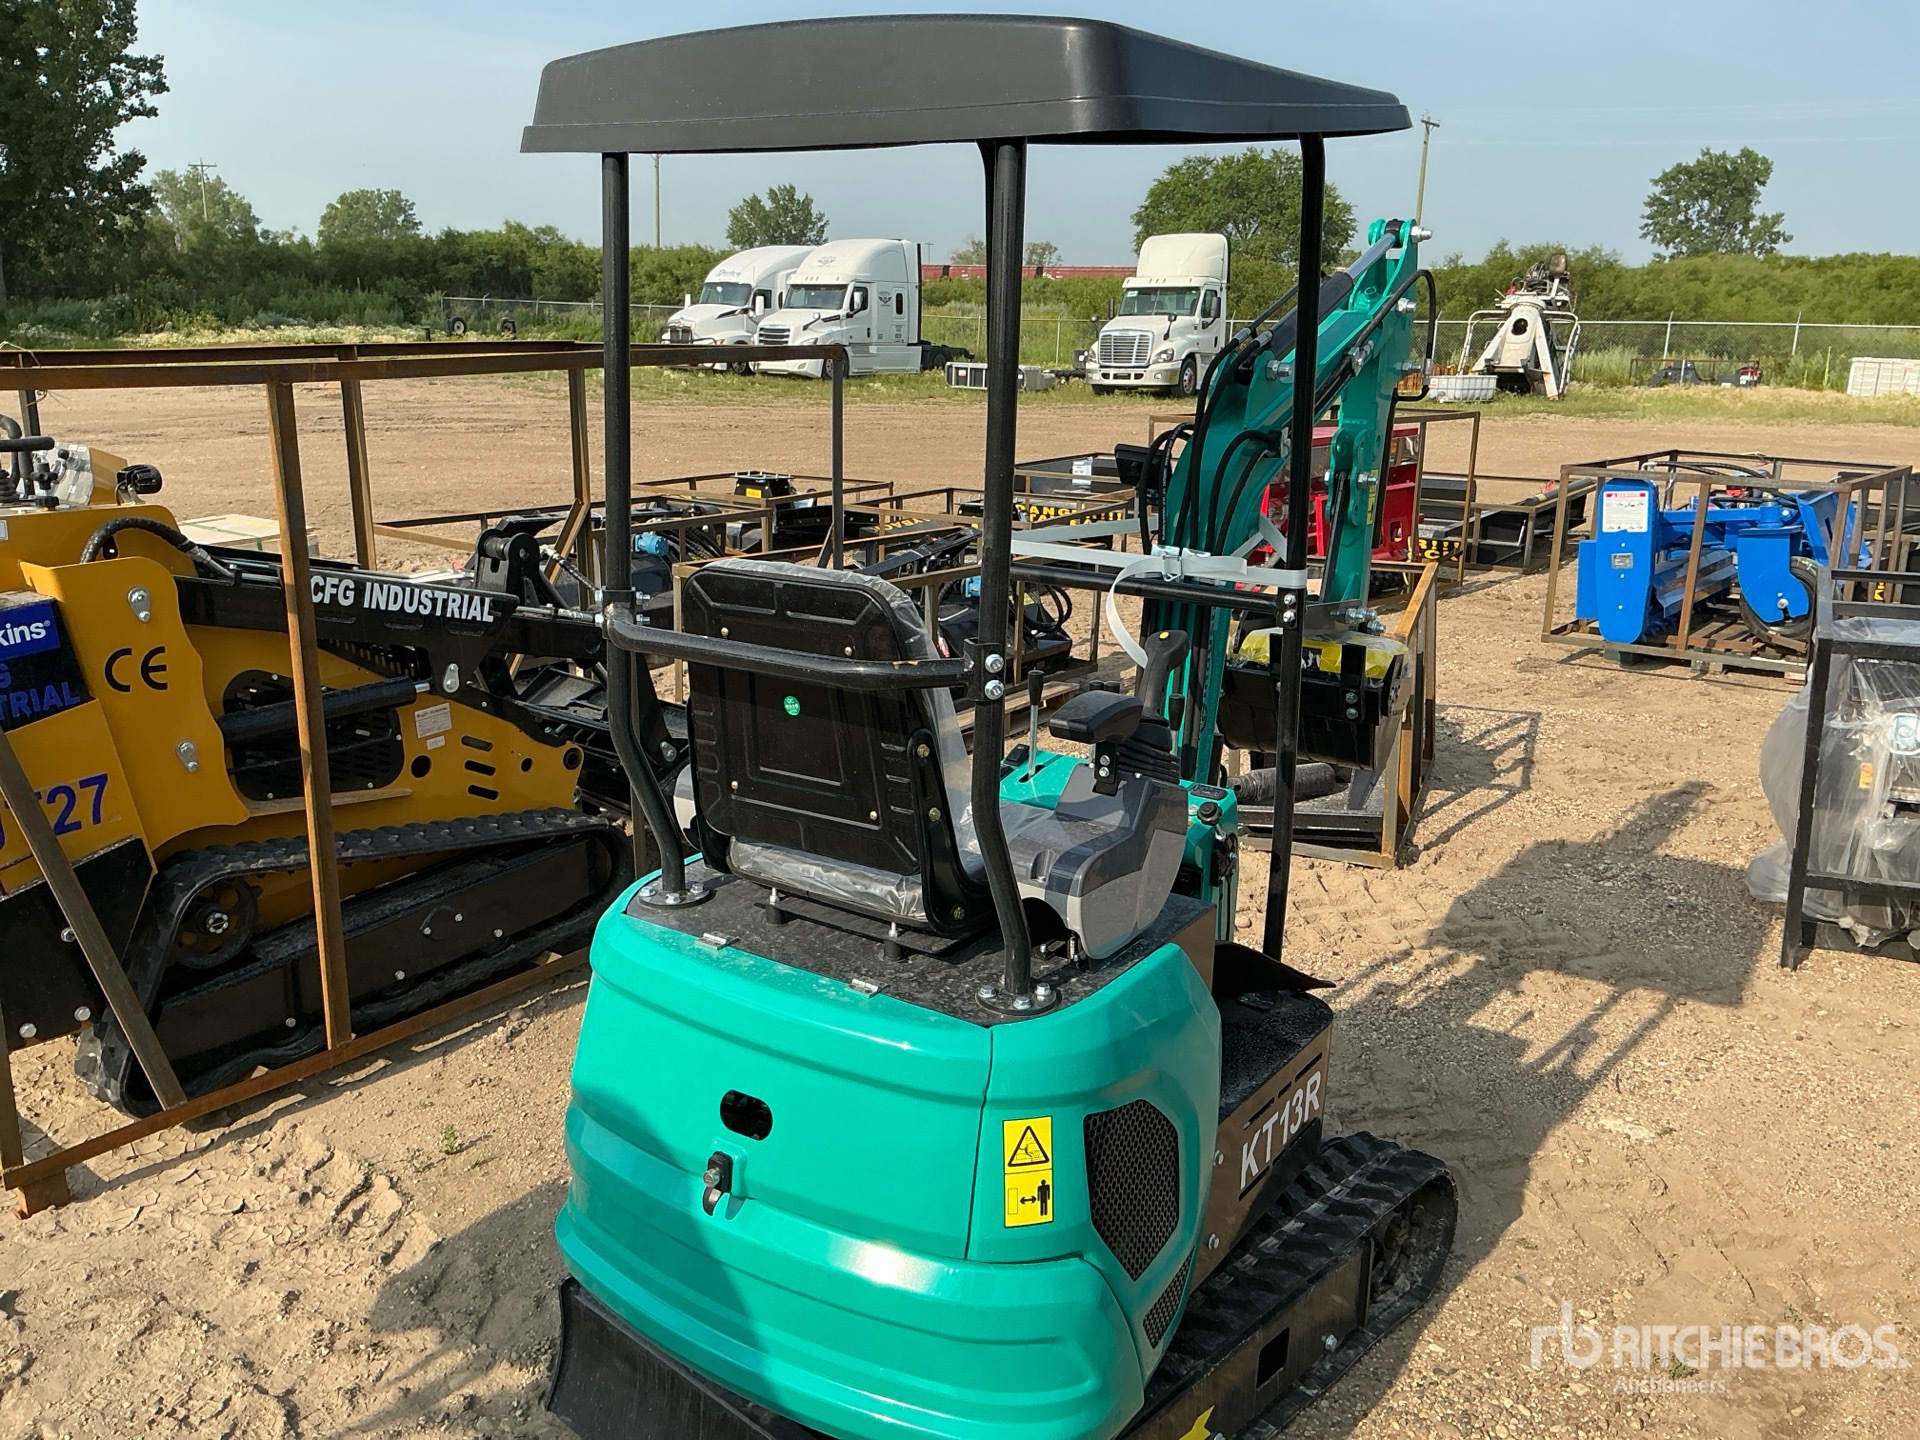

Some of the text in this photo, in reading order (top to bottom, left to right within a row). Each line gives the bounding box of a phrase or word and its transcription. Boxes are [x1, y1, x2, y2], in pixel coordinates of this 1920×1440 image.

[310, 575, 495, 623] CFG INDUSTRIAL
[1240, 1070, 1321, 1191] KT13R
